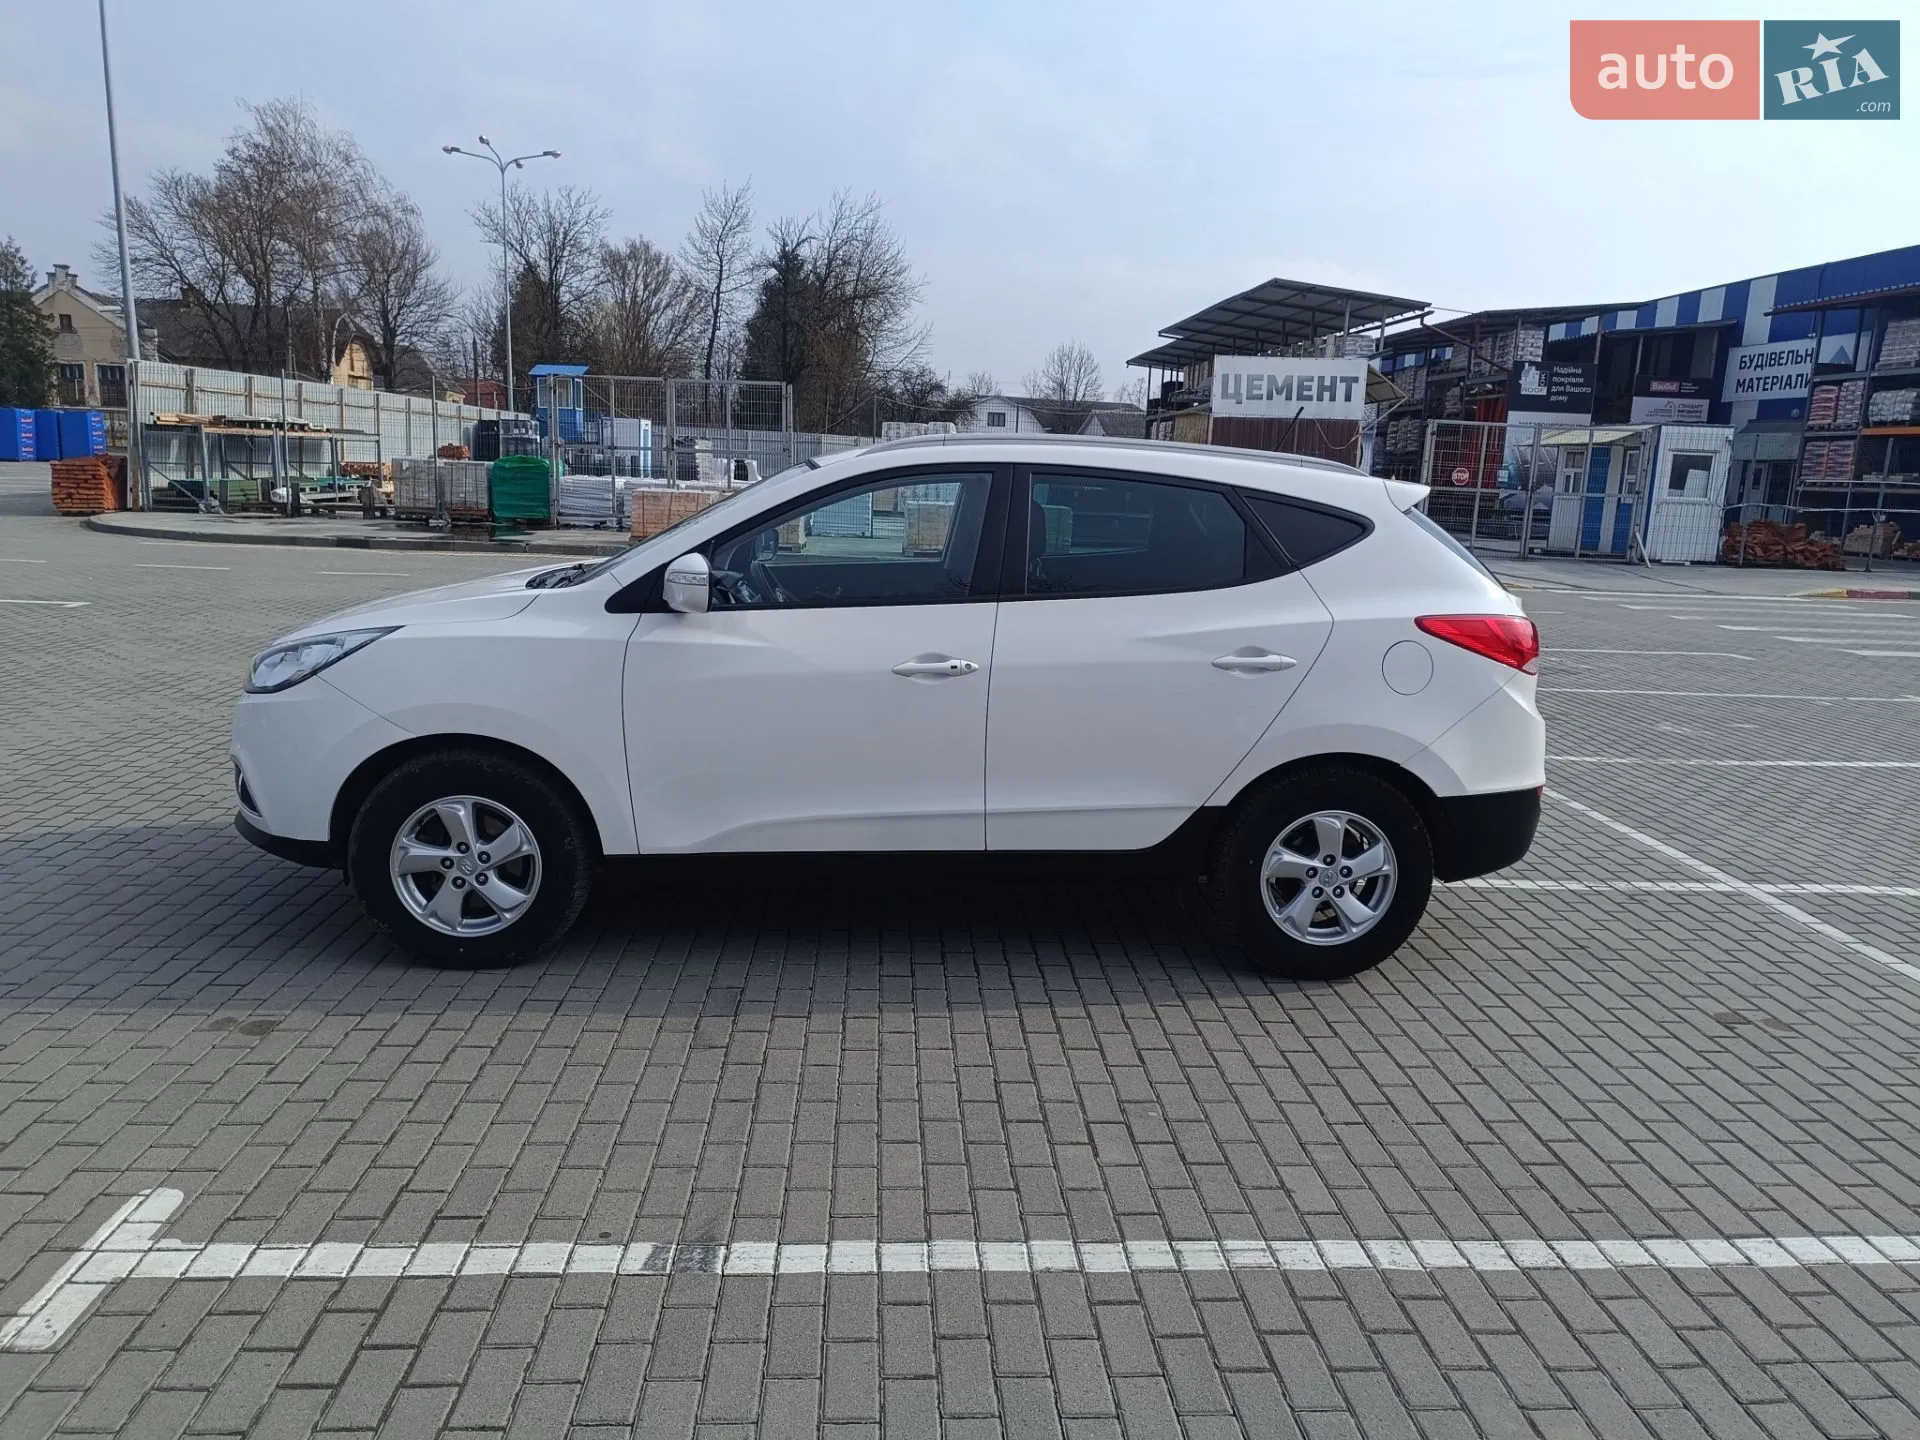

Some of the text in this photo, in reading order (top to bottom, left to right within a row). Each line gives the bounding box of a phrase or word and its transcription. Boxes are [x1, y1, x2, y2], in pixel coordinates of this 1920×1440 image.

[1739, 347, 1815, 371] БУДІВЕЛЬН
[1553, 366, 1582, 374] Надійна
[1221, 373, 1360, 405] ЦЕМЕНТ
[1566, 385, 1592, 394] Вашого
[1453, 472, 1469, 480] STOP
